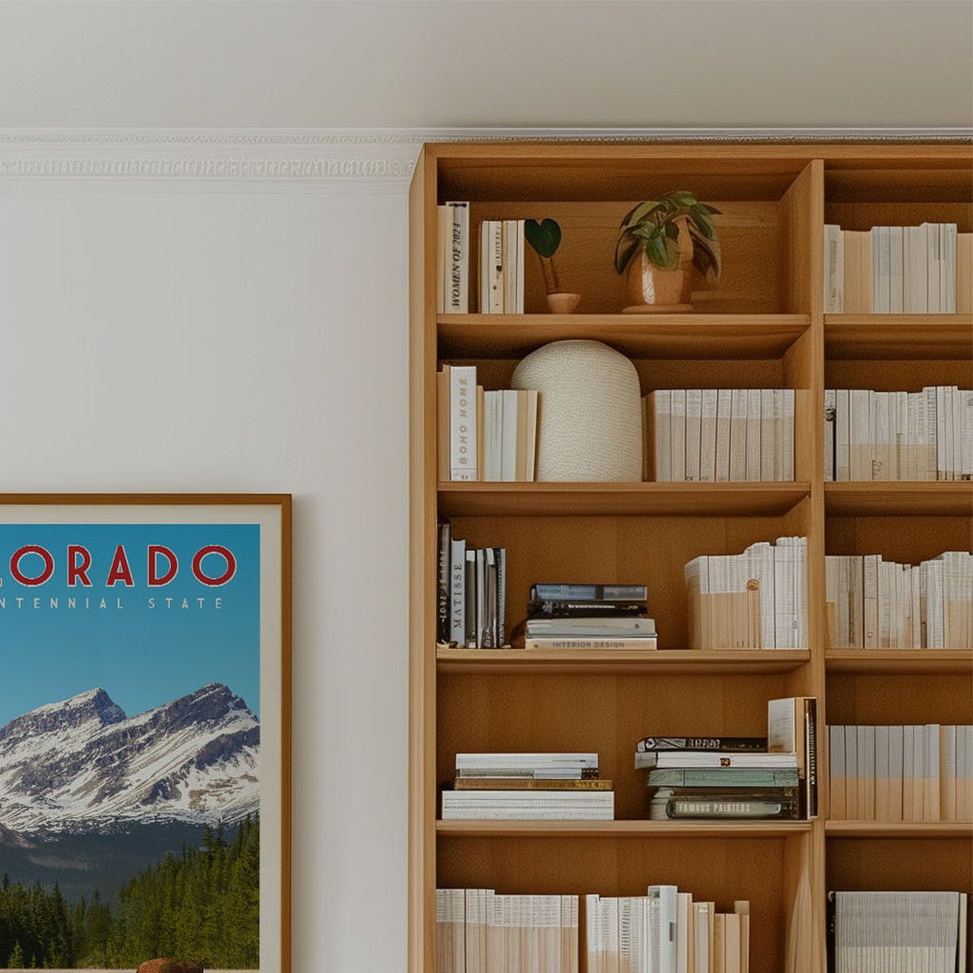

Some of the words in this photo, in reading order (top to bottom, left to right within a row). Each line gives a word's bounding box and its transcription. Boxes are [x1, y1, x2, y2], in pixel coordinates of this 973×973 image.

[452, 246, 461, 262] OF
[452, 264, 461, 308] WOMEN
[459, 378, 467, 418] HOME
[459, 425, 467, 465] BOHO
[148, 597, 224, 609] STATE
[454, 563, 463, 629] MATISSE
[552, 641, 591, 649] INTERIOR
[594, 641, 625, 649] DESIGN
[678, 803, 711, 812] FAMOUS
[713, 803, 751, 812] PAINTERS
